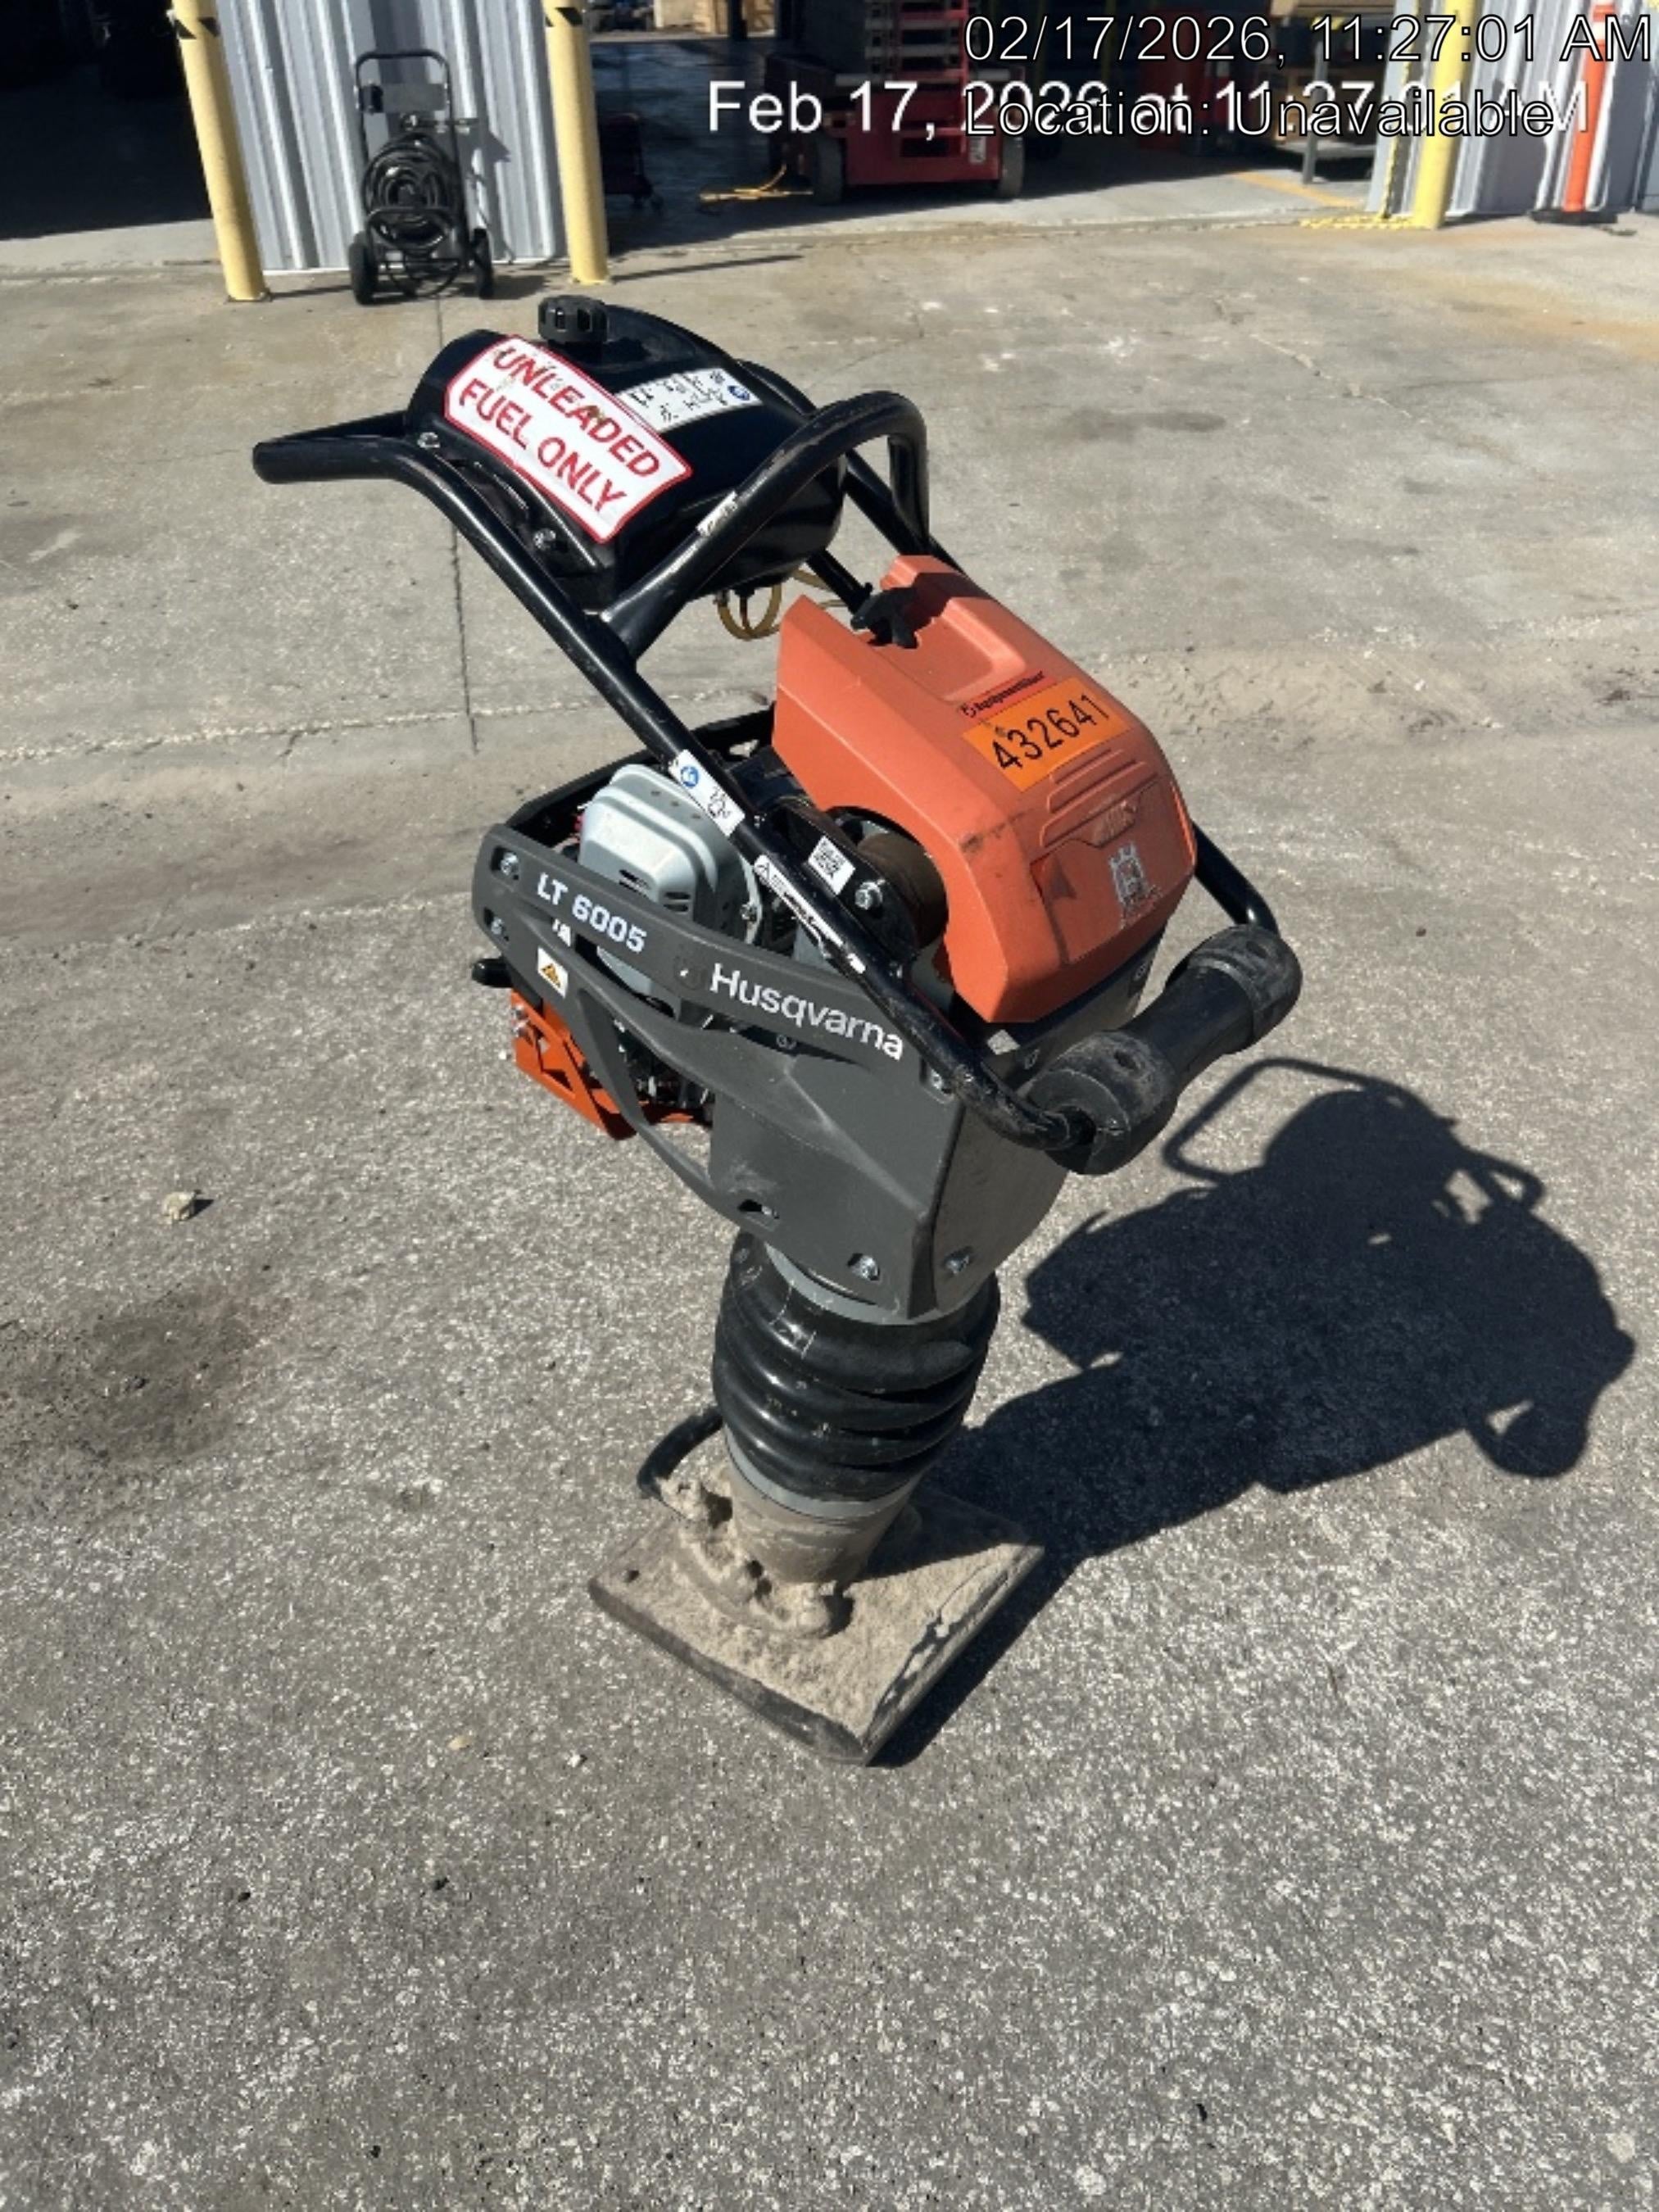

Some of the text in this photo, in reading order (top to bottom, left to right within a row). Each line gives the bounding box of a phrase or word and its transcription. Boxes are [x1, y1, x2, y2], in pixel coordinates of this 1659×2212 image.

[459, 377, 530, 451] FUEL
[537, 437, 628, 514] ONLY
[492, 346, 660, 478] UNLEADED
[990, 693, 1111, 771] 432641
[537, 872, 647, 955] LT 6005
[709, 962, 904, 1062] Husqvarna
